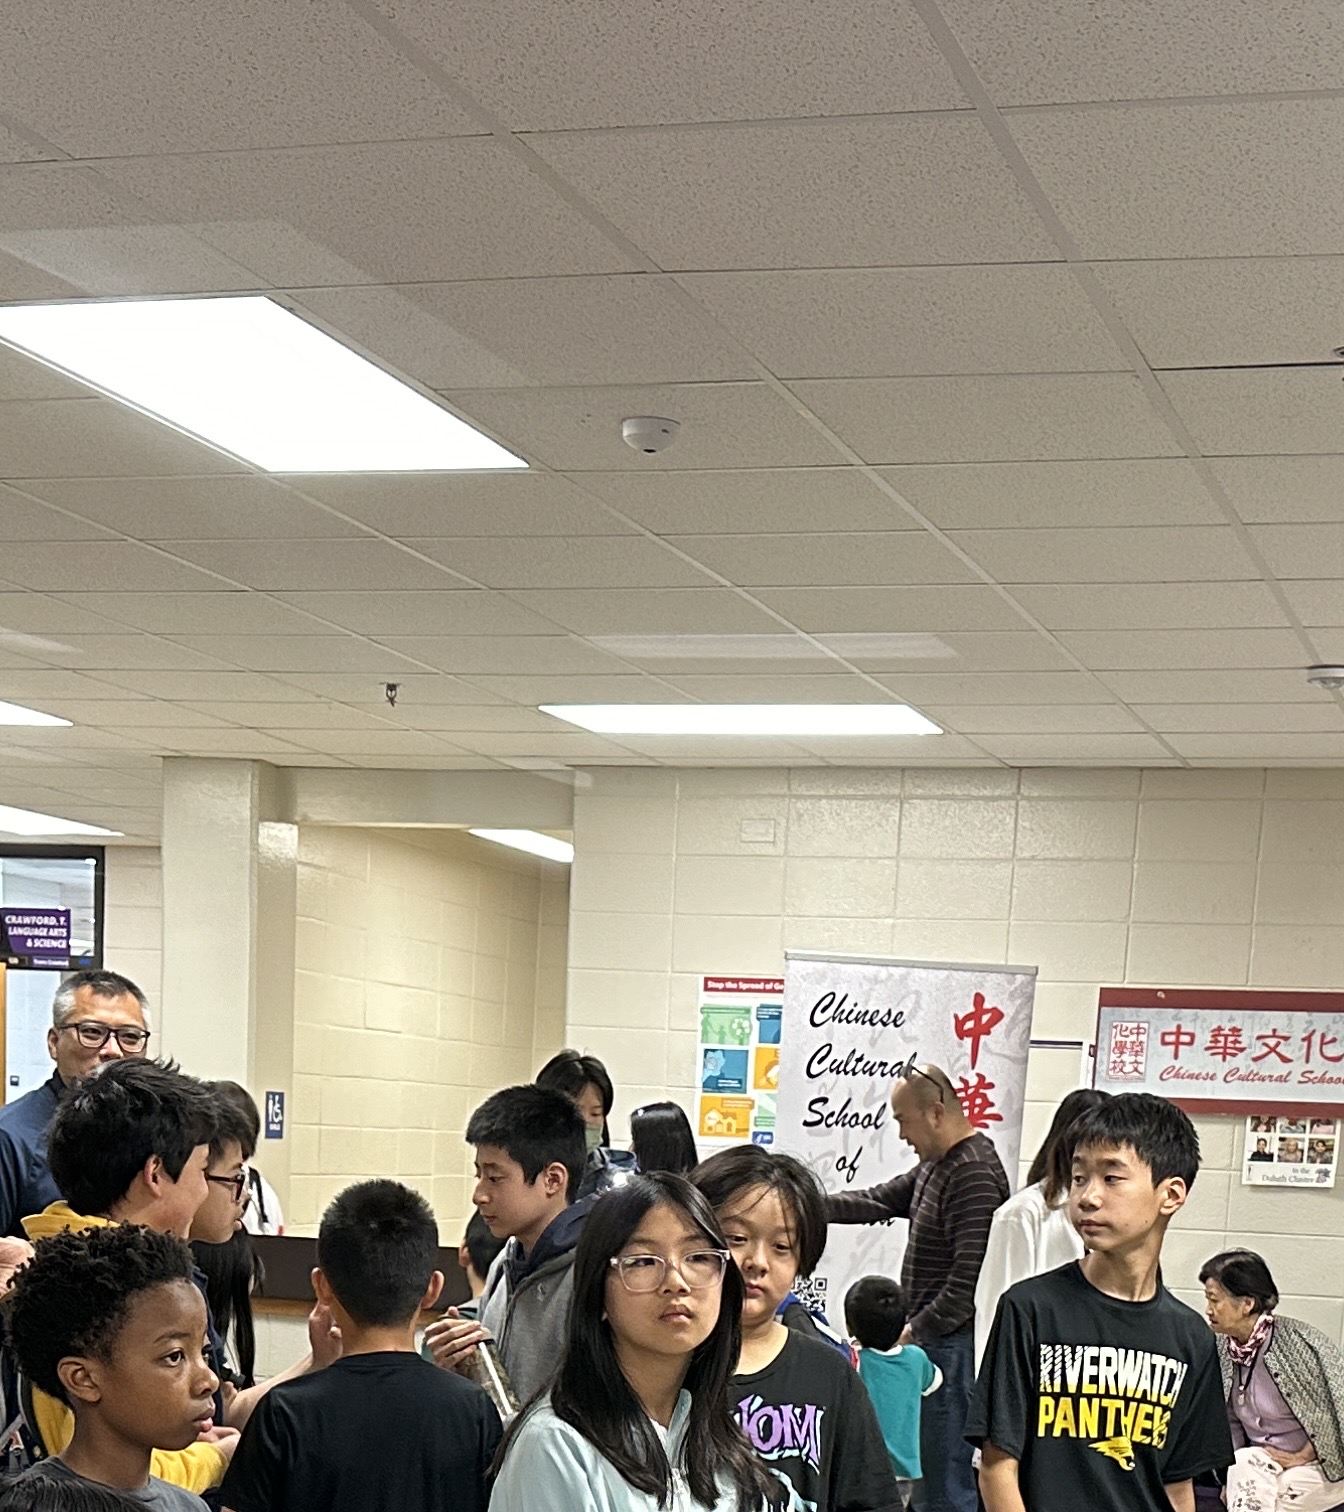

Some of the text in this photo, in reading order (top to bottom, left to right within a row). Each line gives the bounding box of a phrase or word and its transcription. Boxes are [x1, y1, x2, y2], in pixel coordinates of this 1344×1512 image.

[8, 927, 67, 937] LANGUAGE ARTS
[34, 939, 67, 948] SCIENCE
[739, 981, 764, 990] Spread
[809, 991, 906, 1028] Chinese
[1159, 1065, 1217, 1082] Chinese
[1223, 1067, 1291, 1083] Cultural
[802, 1096, 887, 1130] School
[835, 1147, 863, 1183] of
[1039, 1343, 1189, 1408] RIVERWATCH
